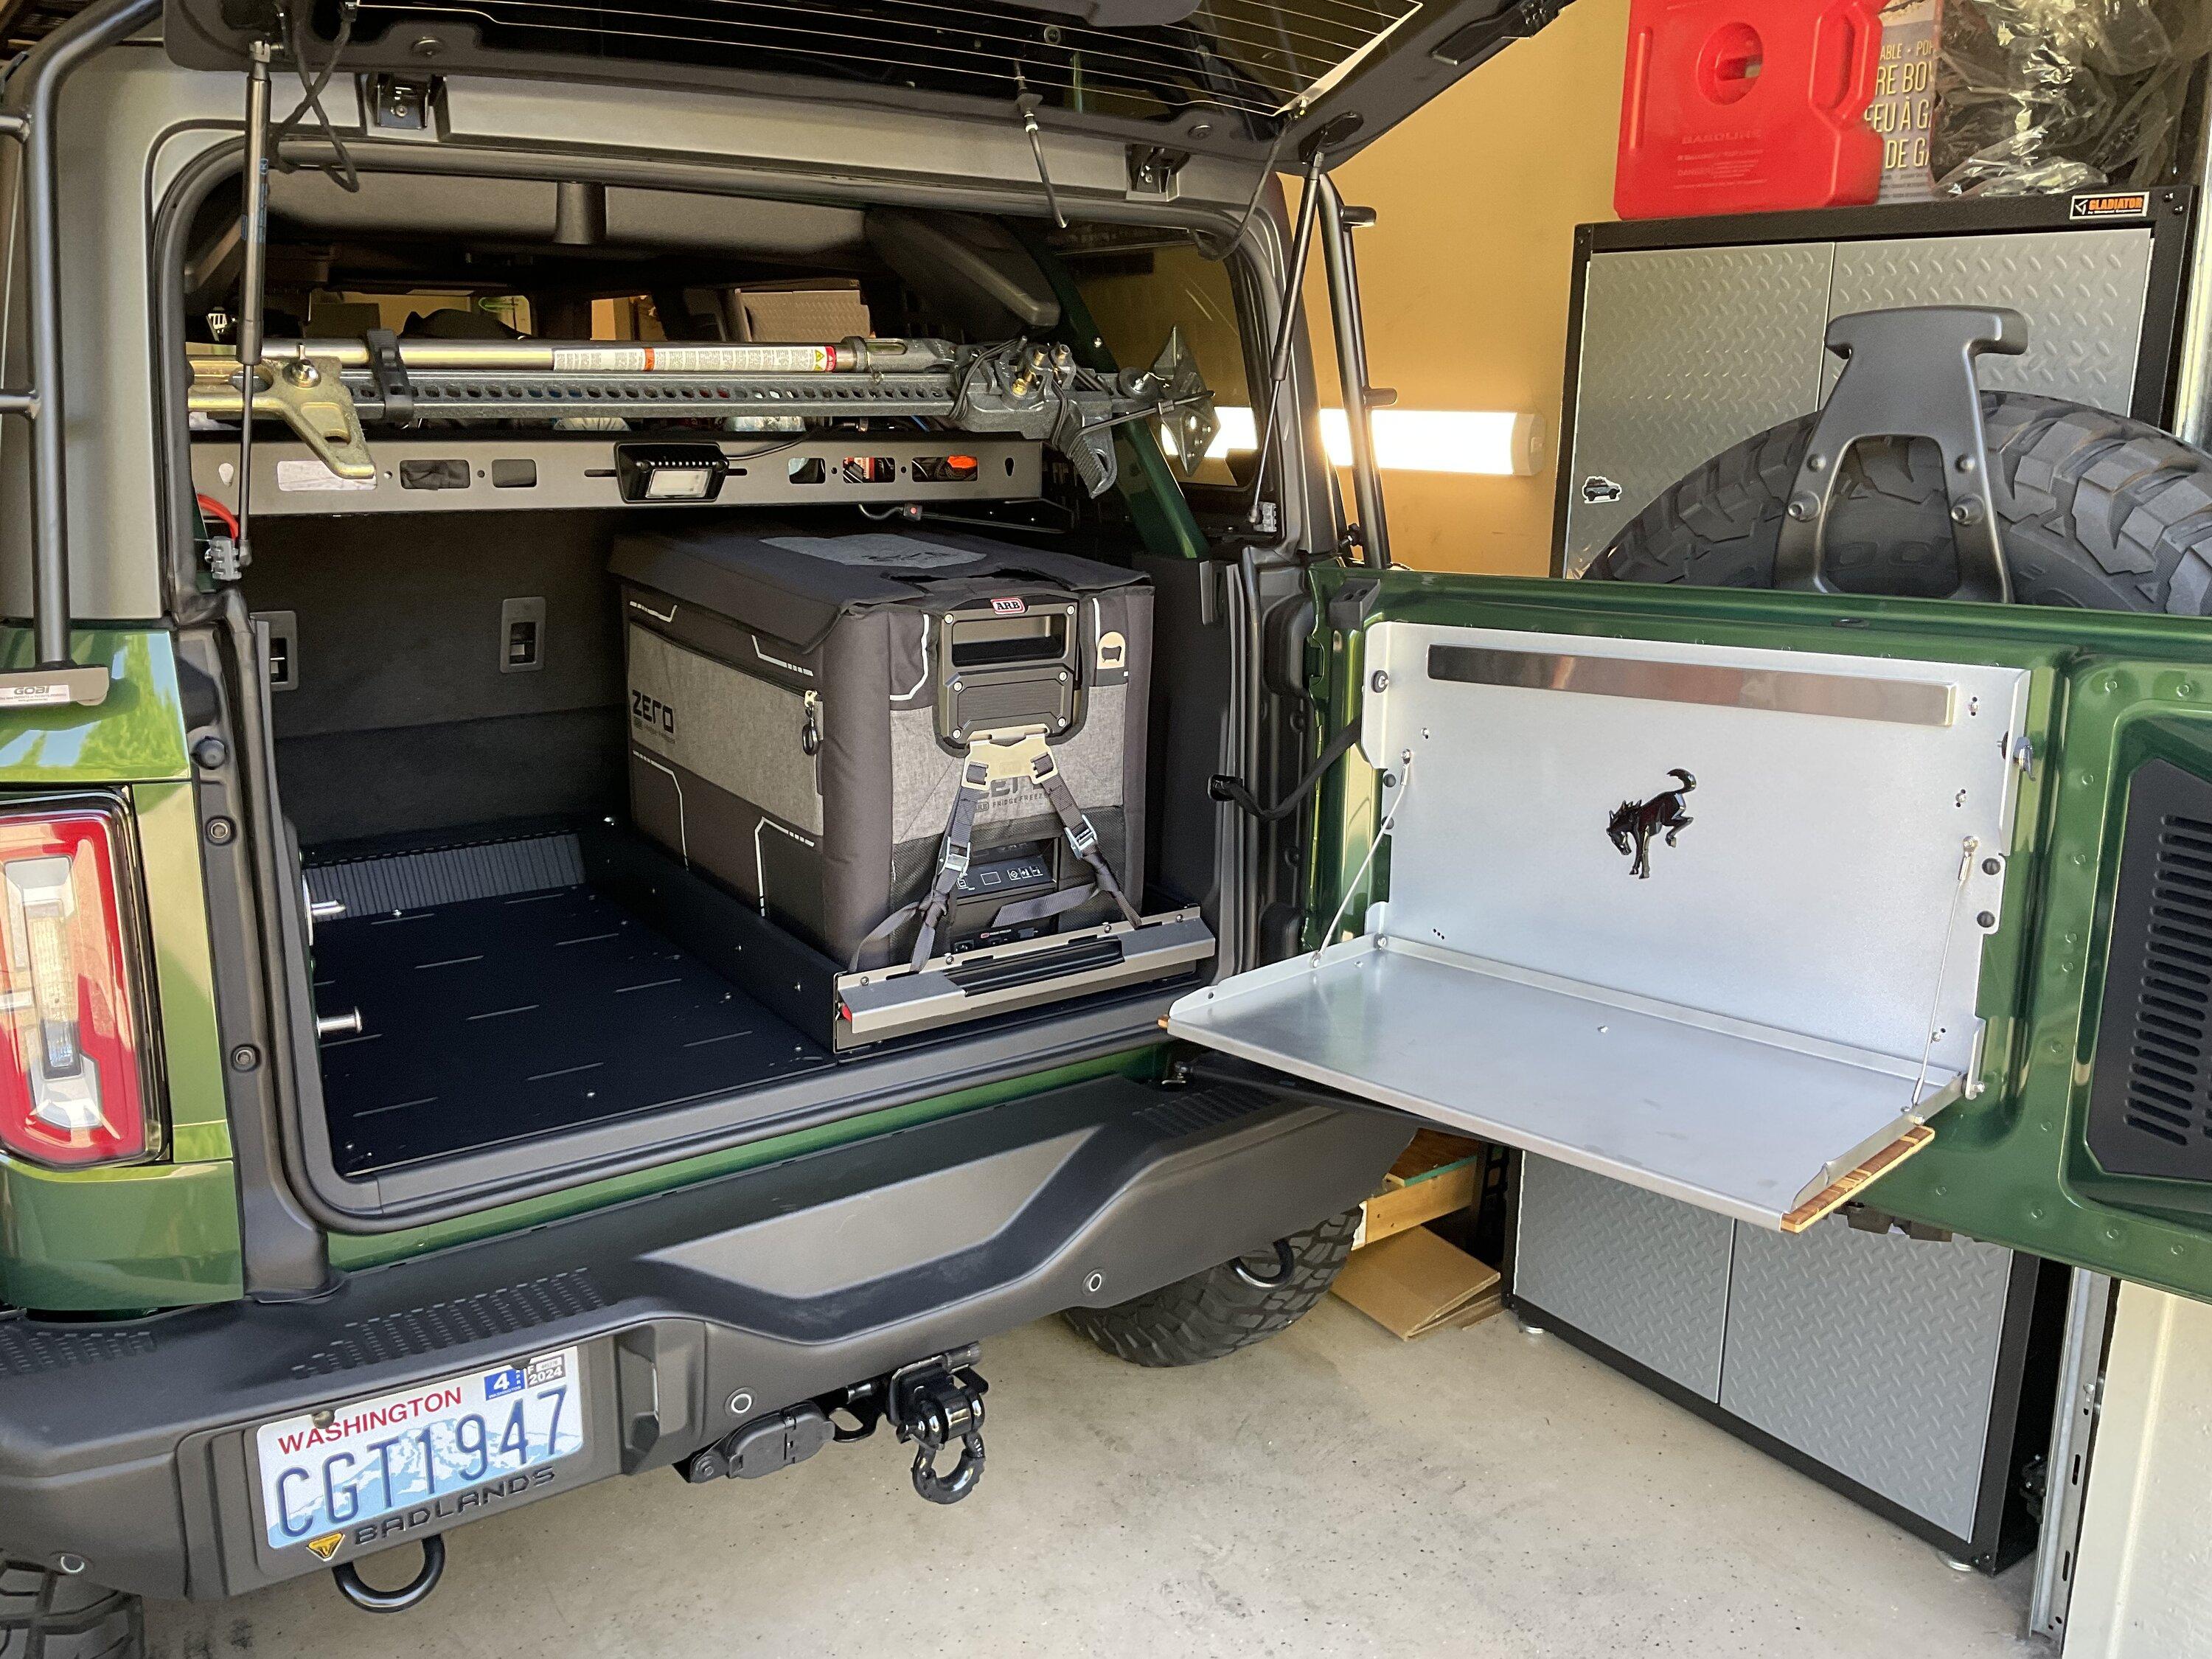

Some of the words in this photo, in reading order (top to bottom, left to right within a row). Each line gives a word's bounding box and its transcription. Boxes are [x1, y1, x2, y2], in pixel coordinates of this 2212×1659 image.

[1917, 99, 1931, 129] G
[1885, 139, 1909, 168] DE
[2089, 196, 2143, 211] GLADIATOR
[995, 601, 1020, 611] ARB
[13, 686, 49, 695] GOBI
[992, 797, 1018, 808] FRIDGE
[1019, 793, 1045, 802] FREEZ
[493, 1372, 510, 1391] 4
[529, 1366, 563, 1385] 2024
[277, 1386, 462, 1455] WASHINGTON
[276, 1384, 568, 1537] CGT1947
[355, 1467, 555, 1545] BADLANDS
